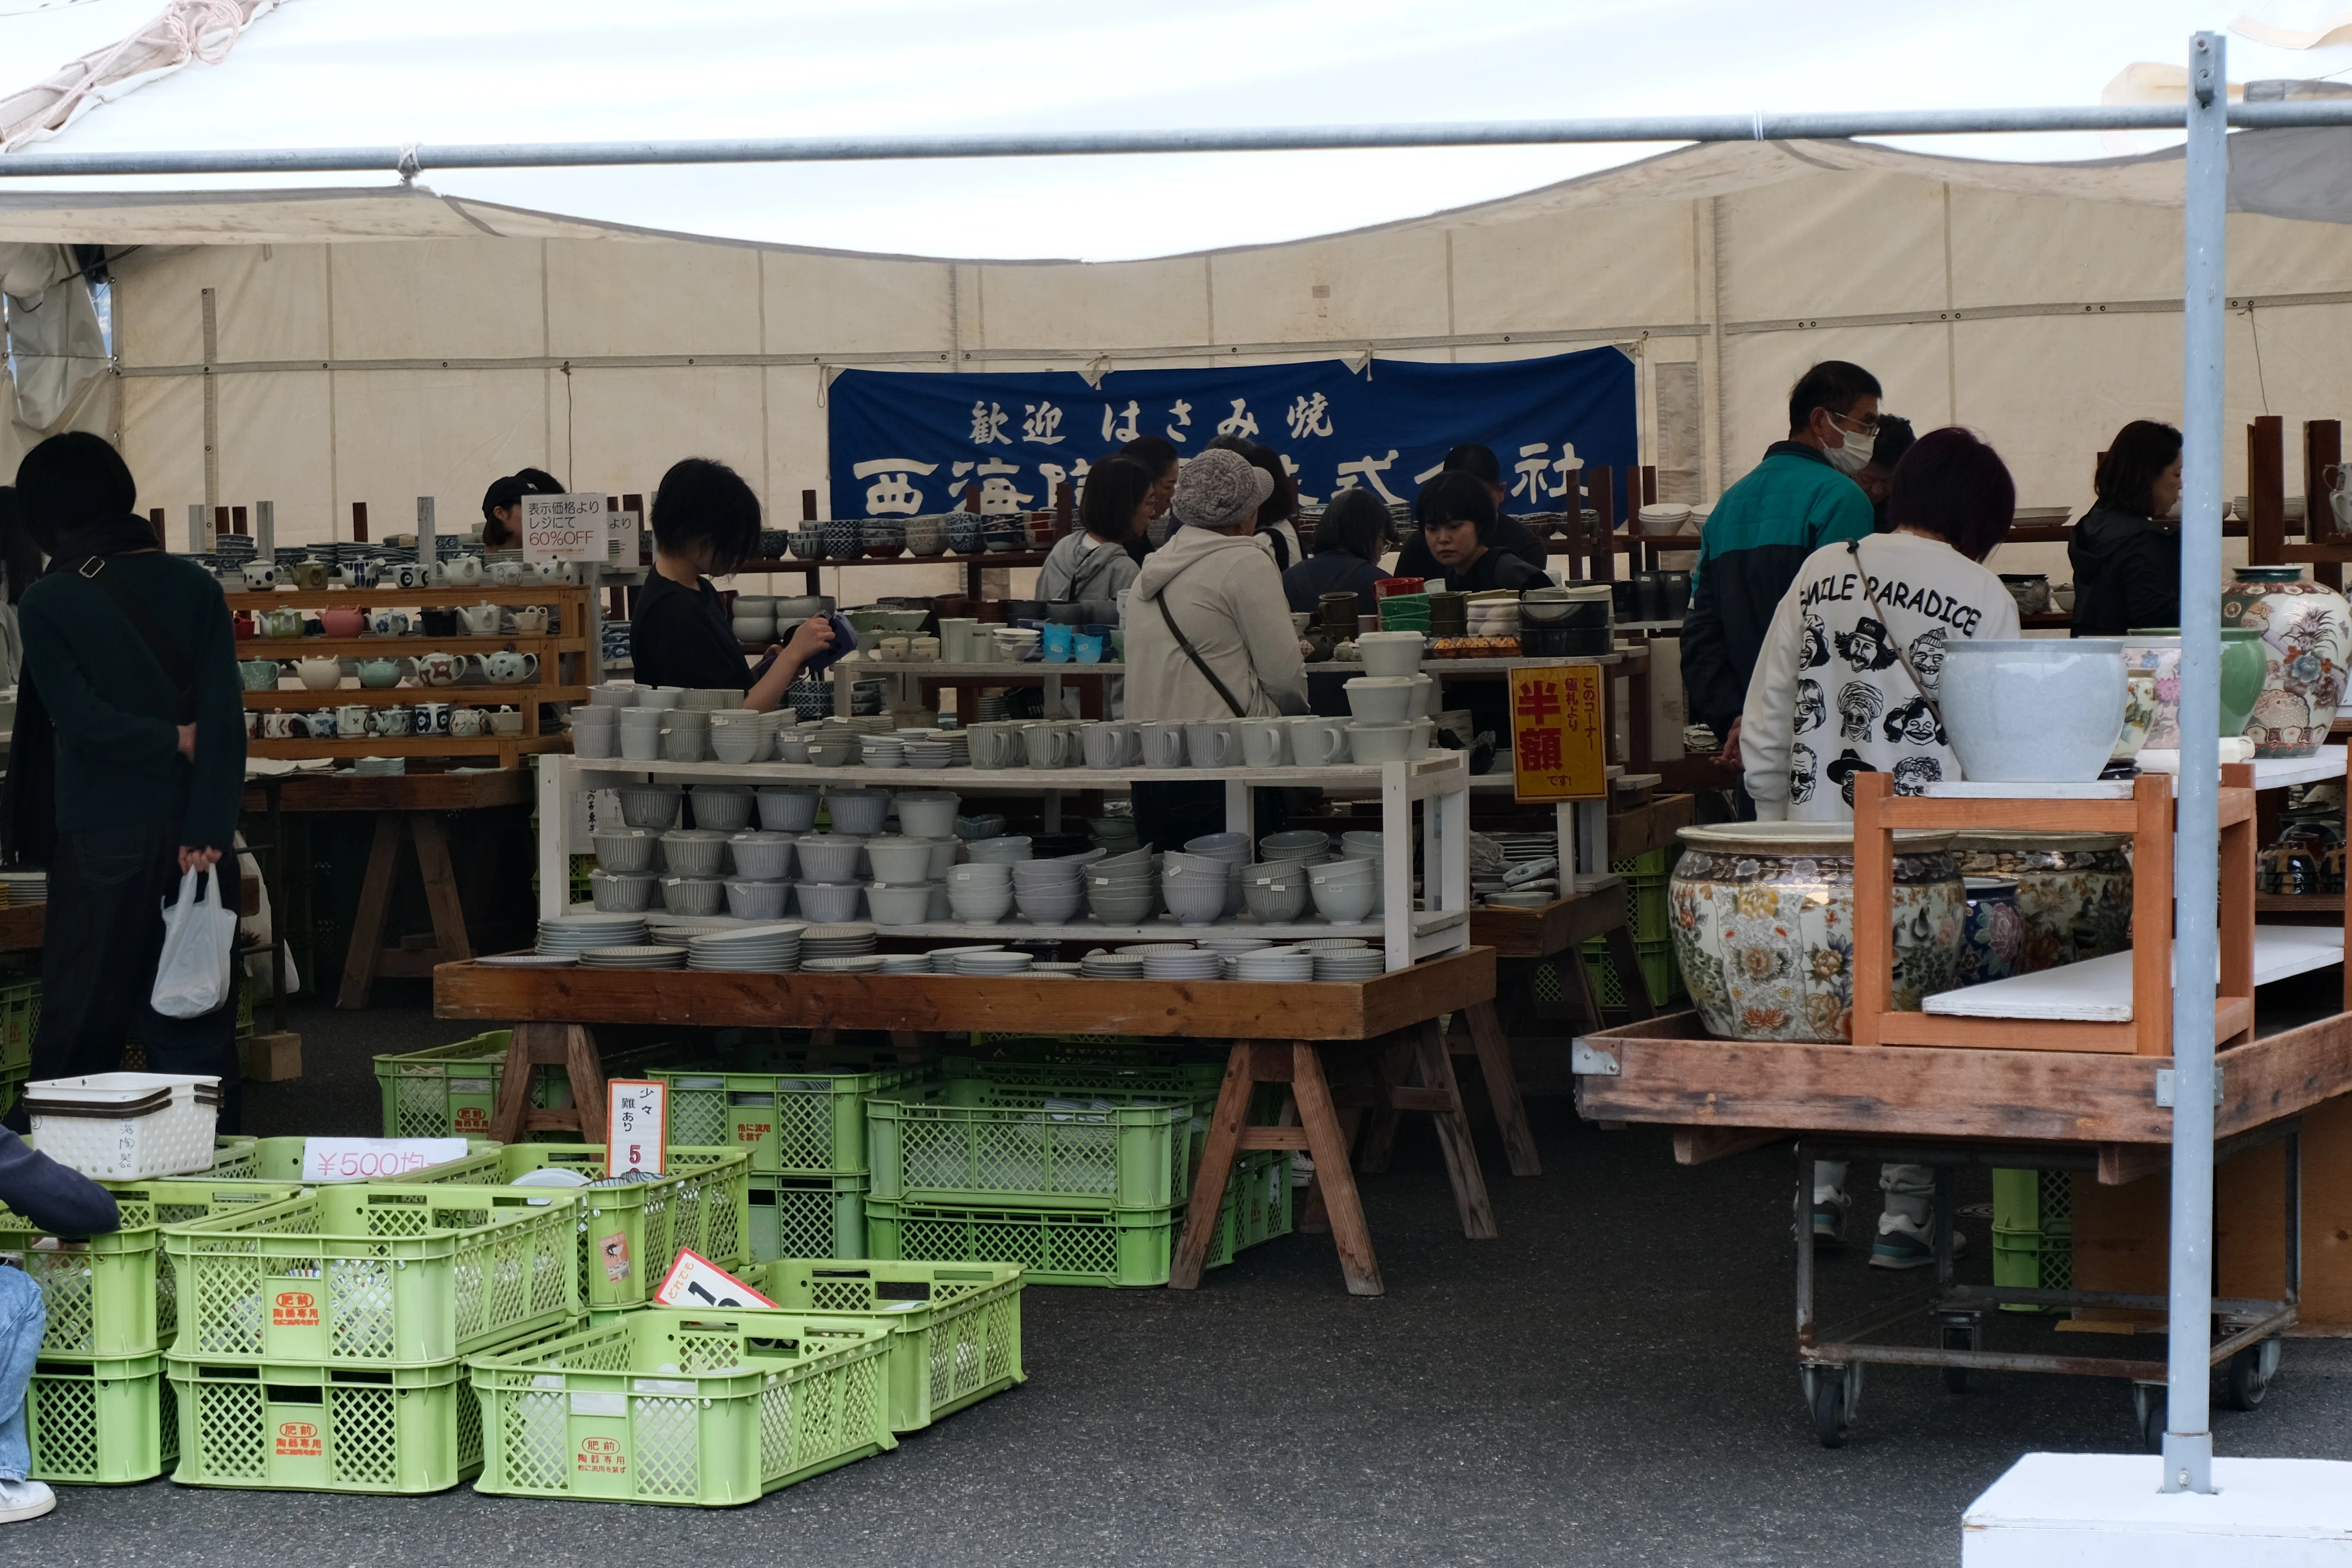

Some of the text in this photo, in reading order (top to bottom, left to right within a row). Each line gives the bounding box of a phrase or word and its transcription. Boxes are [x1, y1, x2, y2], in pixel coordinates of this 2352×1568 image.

[529, 501, 599, 515] 表示価格より
[530, 516, 576, 529] レジにて
[530, 531, 594, 546] 60%OFF
[1863, 576, 1983, 637] PARADICE
[1565, 678, 1579, 733] 値札より
[1583, 677, 1598, 751] このコーナー
[1517, 680, 1564, 771] 半額
[621, 1097, 636, 1132] 難あり
[640, 1087, 654, 1115] 少々
[629, 1144, 641, 1172] 5
[578, 1453, 625, 1465] 陶器専用
[588, 1440, 615, 1452] 肥前
